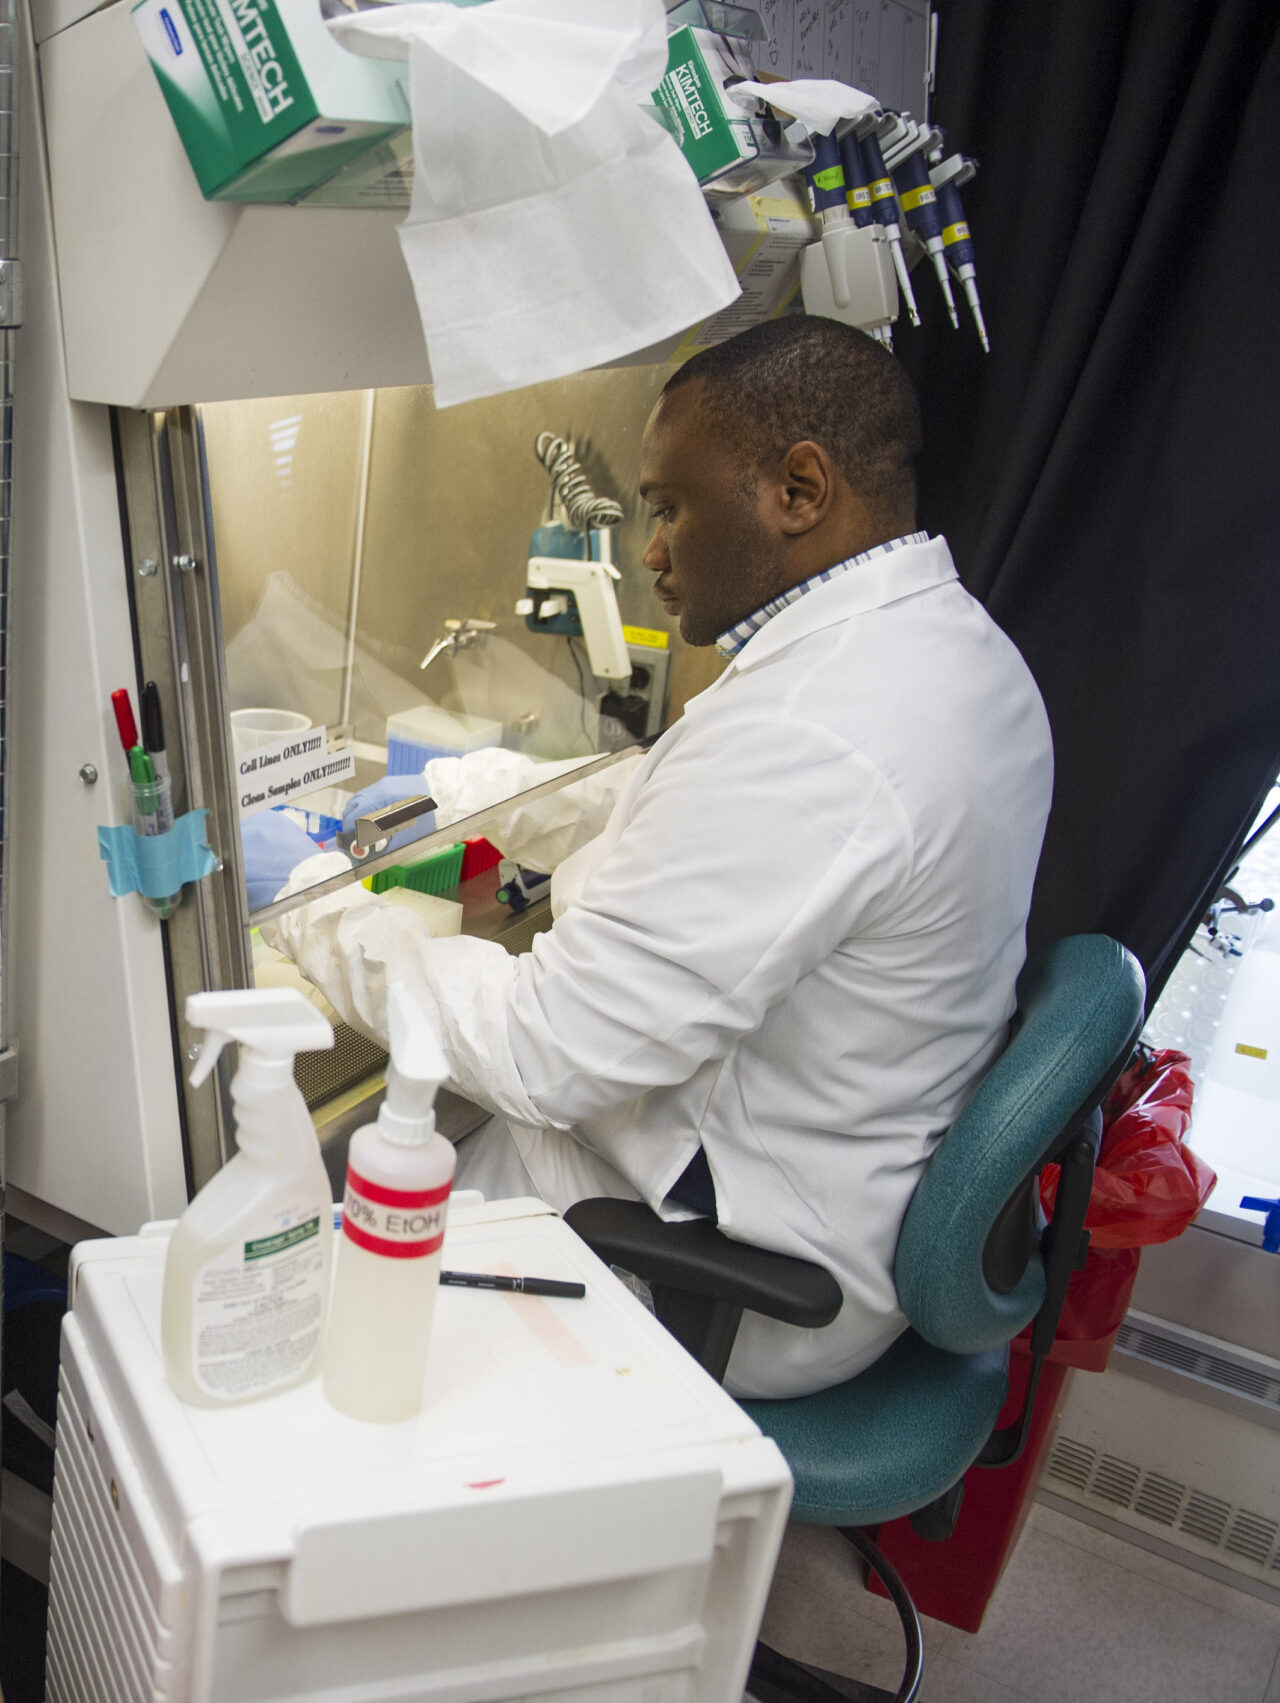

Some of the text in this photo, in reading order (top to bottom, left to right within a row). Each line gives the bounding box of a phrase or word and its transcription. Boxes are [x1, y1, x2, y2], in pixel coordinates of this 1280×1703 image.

[231, 0, 294, 114] MTECH
[675, 63, 713, 136] KIMTECH
[240, 758, 257, 775] Cell
[260, 753, 281, 769] Lines
[241, 792, 265, 808] Clean
[268, 778, 301, 798] Samples
[385, 1212, 440, 1234] EtOH
